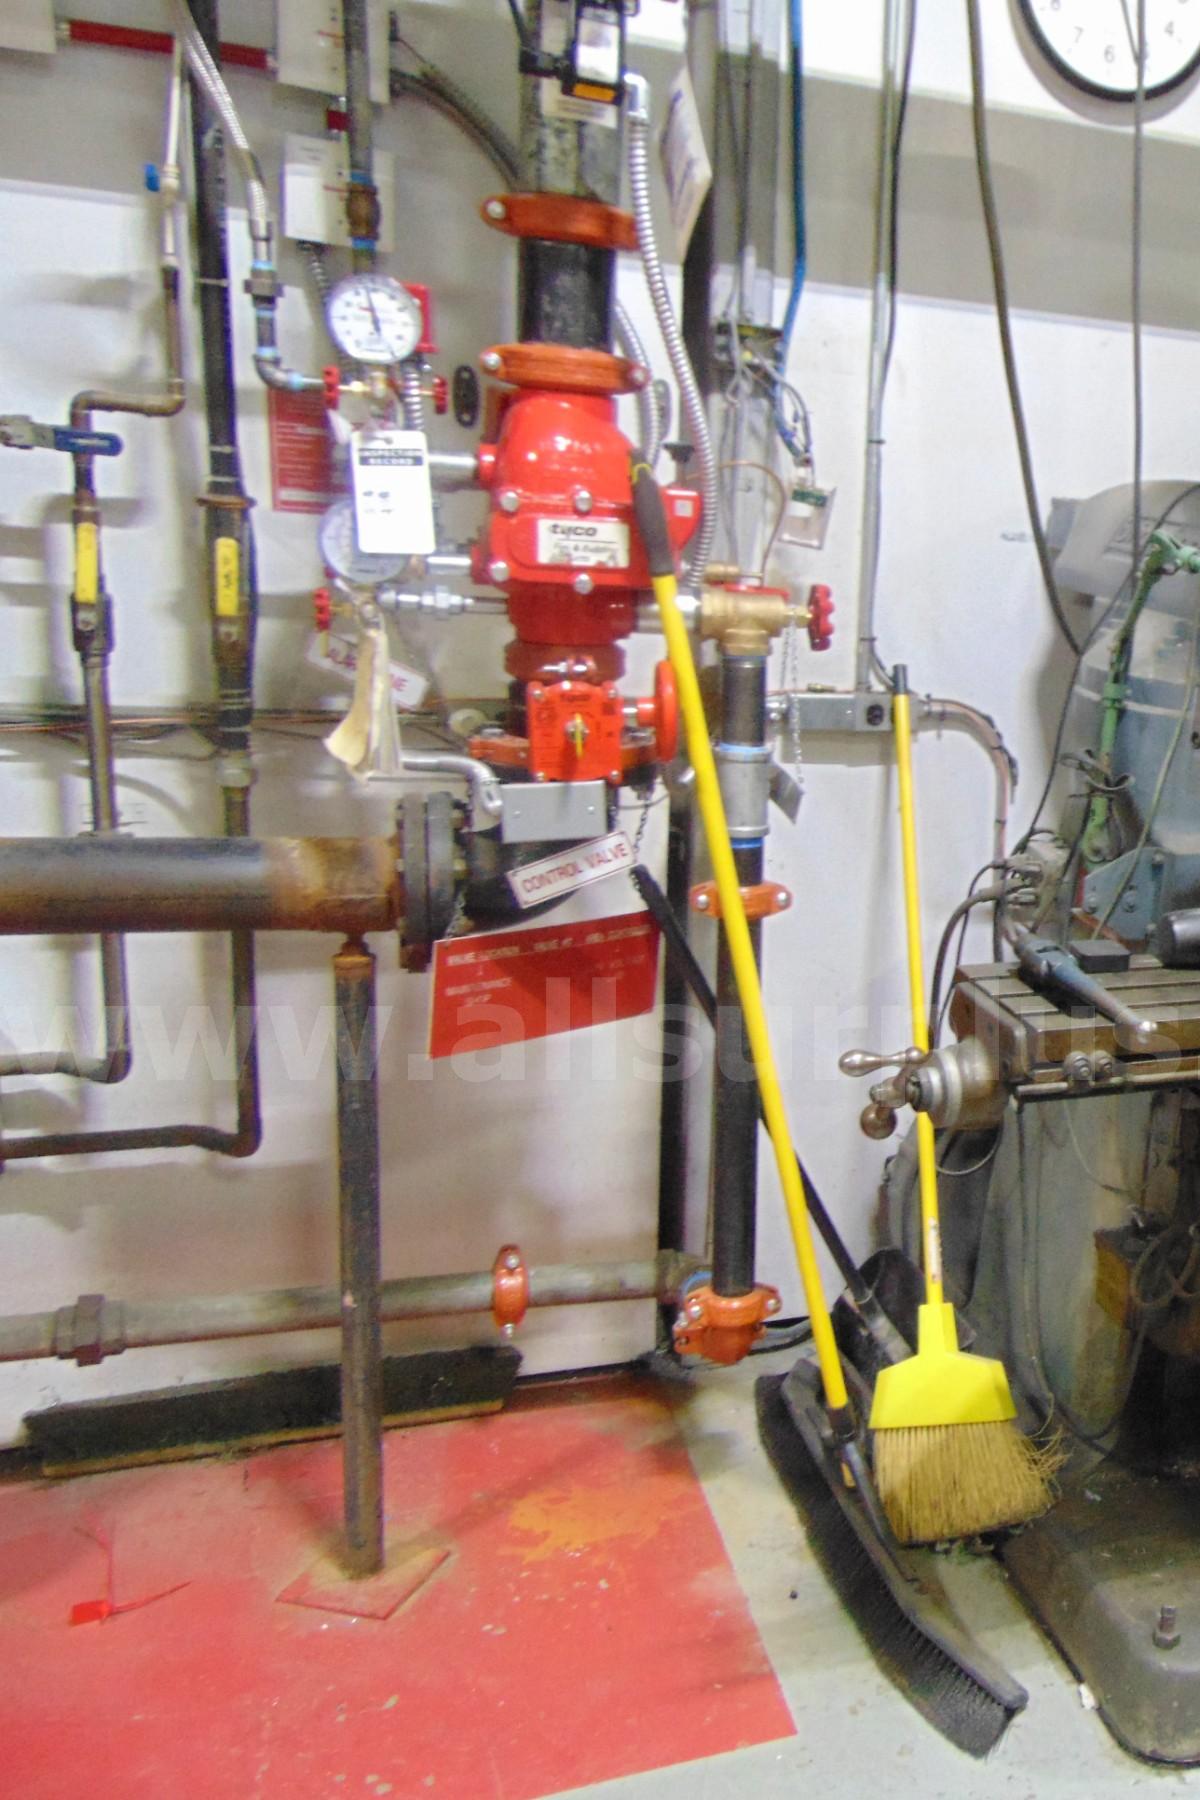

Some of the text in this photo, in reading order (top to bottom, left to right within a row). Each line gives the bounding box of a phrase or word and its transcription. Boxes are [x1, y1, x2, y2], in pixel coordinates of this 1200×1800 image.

[1073, 26, 1084, 44] 7
[1164, 21, 1174, 37] 4
[1104, 44, 1115, 64] 6
[551, 523, 598, 539] tyco
[522, 842, 629, 893] CONTROL VALVE
